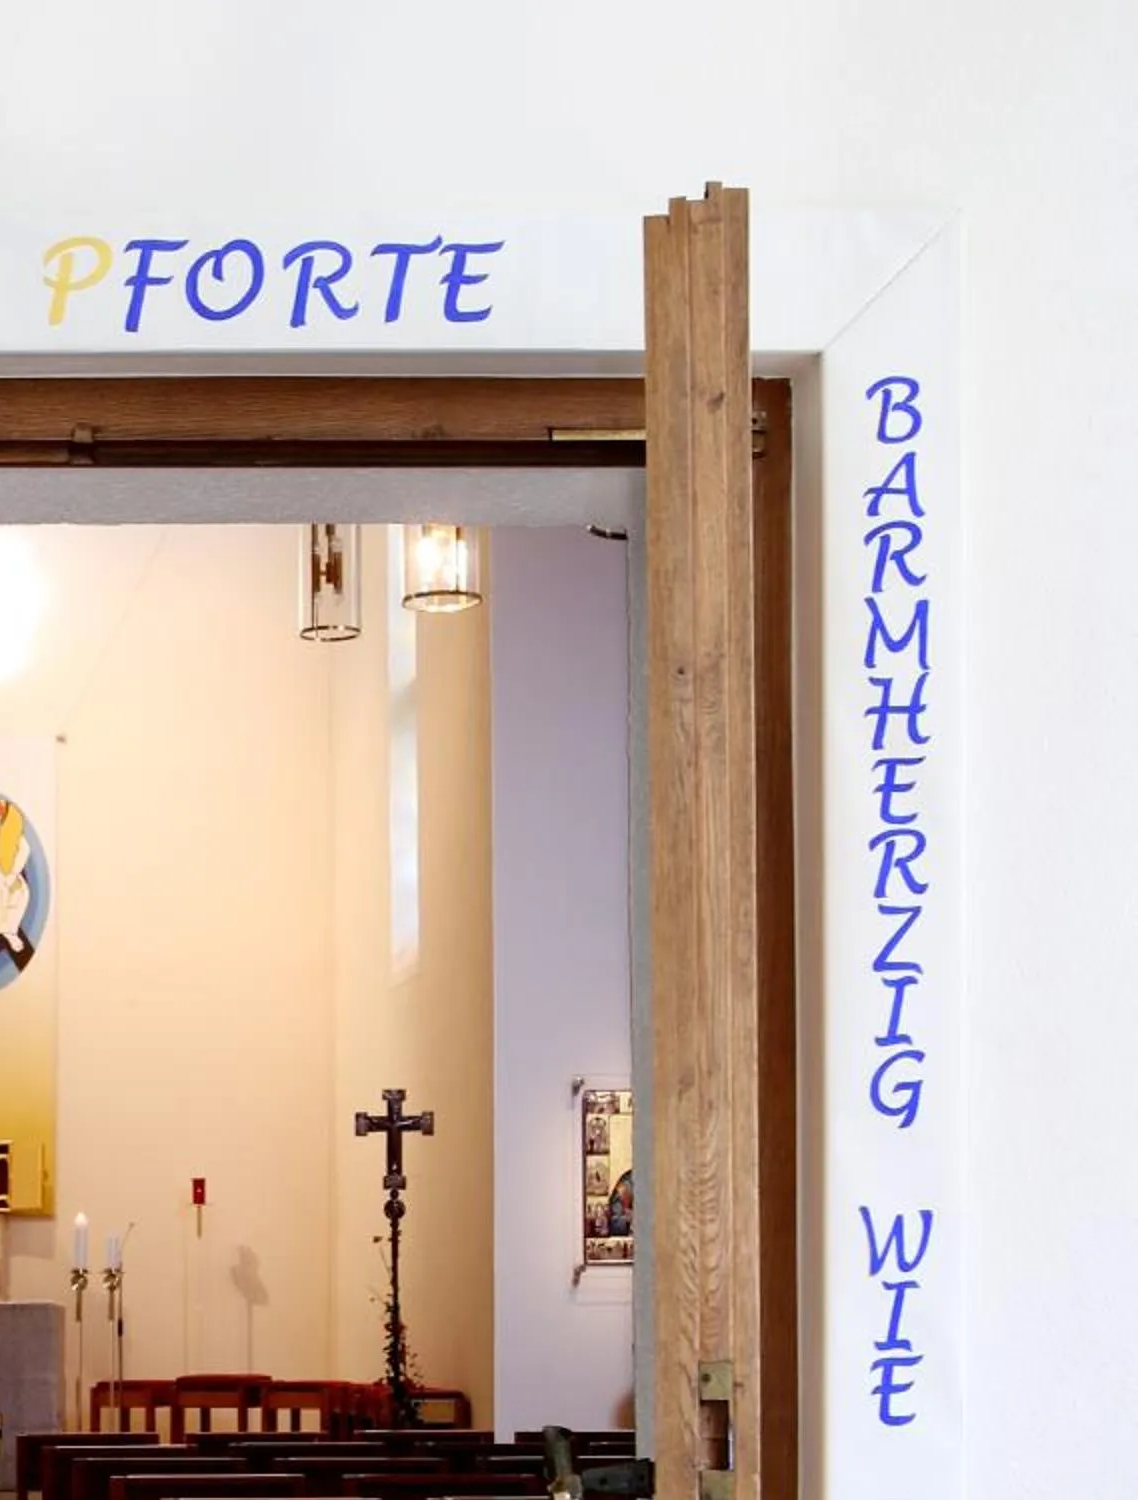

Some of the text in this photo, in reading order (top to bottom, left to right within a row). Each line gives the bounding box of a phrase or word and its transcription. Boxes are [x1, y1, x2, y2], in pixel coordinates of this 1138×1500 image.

[43, 235, 505, 333] PFORTE
[862, 375, 932, 1129] BARMHERZIG
[859, 1206, 935, 1428] WIE
